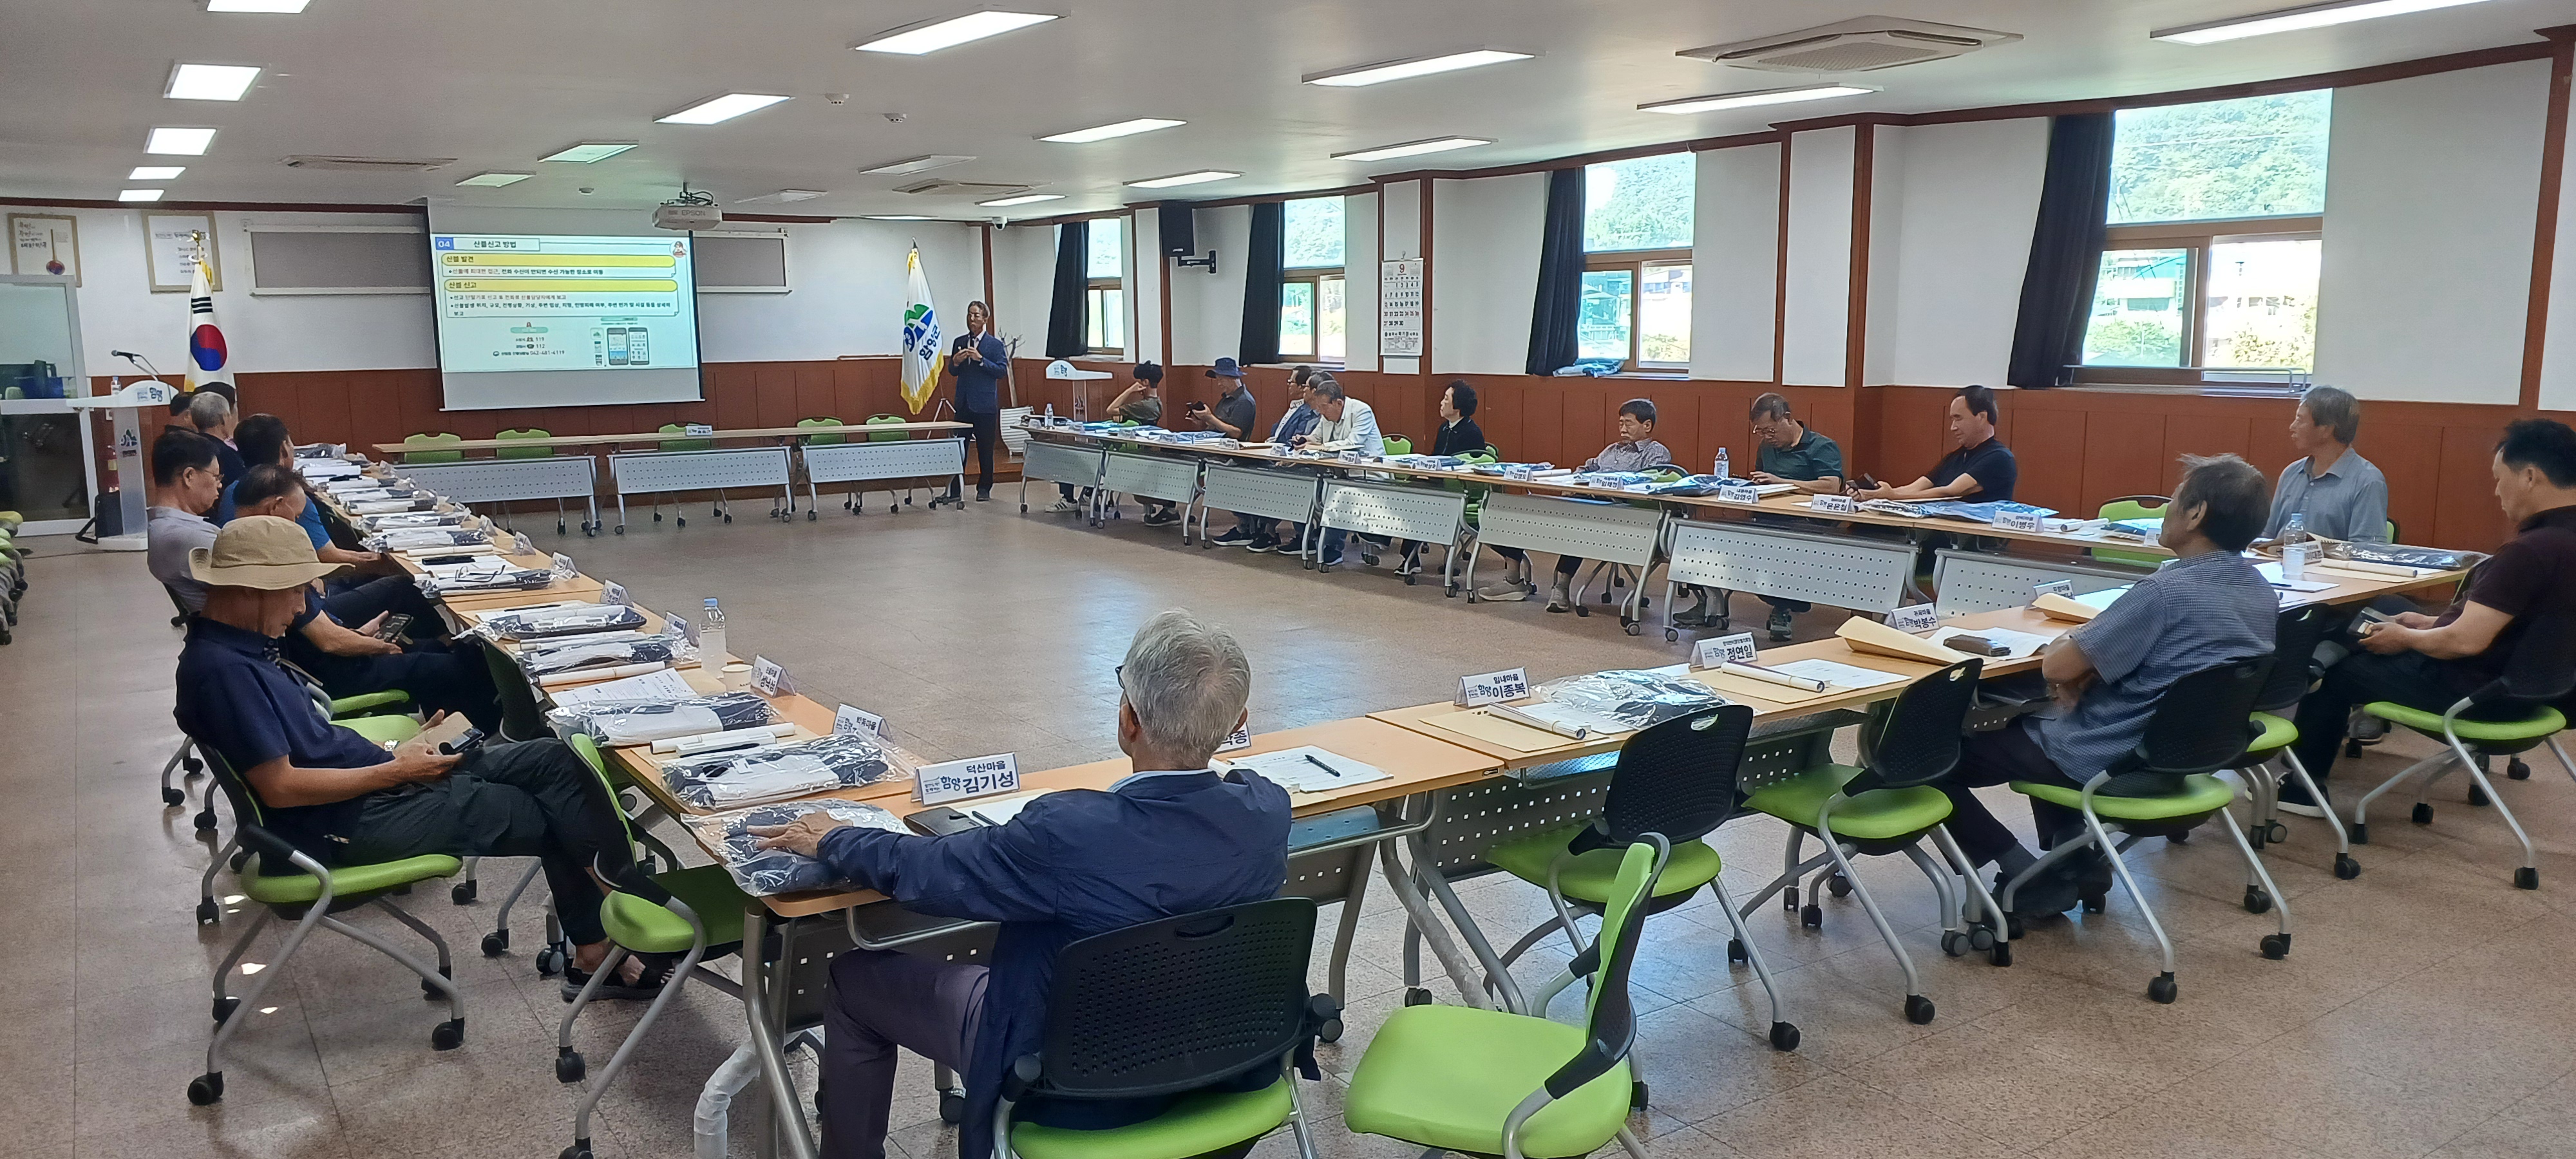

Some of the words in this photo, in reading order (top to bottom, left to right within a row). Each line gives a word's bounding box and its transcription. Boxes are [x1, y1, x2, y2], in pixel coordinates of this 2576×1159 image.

[1399, 264, 1405, 273] 9
[919, 324, 941, 361] 함양군
[1913, 616, 1937, 629] 박봉수
[1727, 644, 1754, 661] 정연일
[1478, 684, 1492, 697] 함양
[1493, 682, 1526, 699] 이종복
[966, 760, 1006, 774] 덕산마을
[940, 776, 961, 791] 함양
[963, 771, 1014, 794] 김기성
